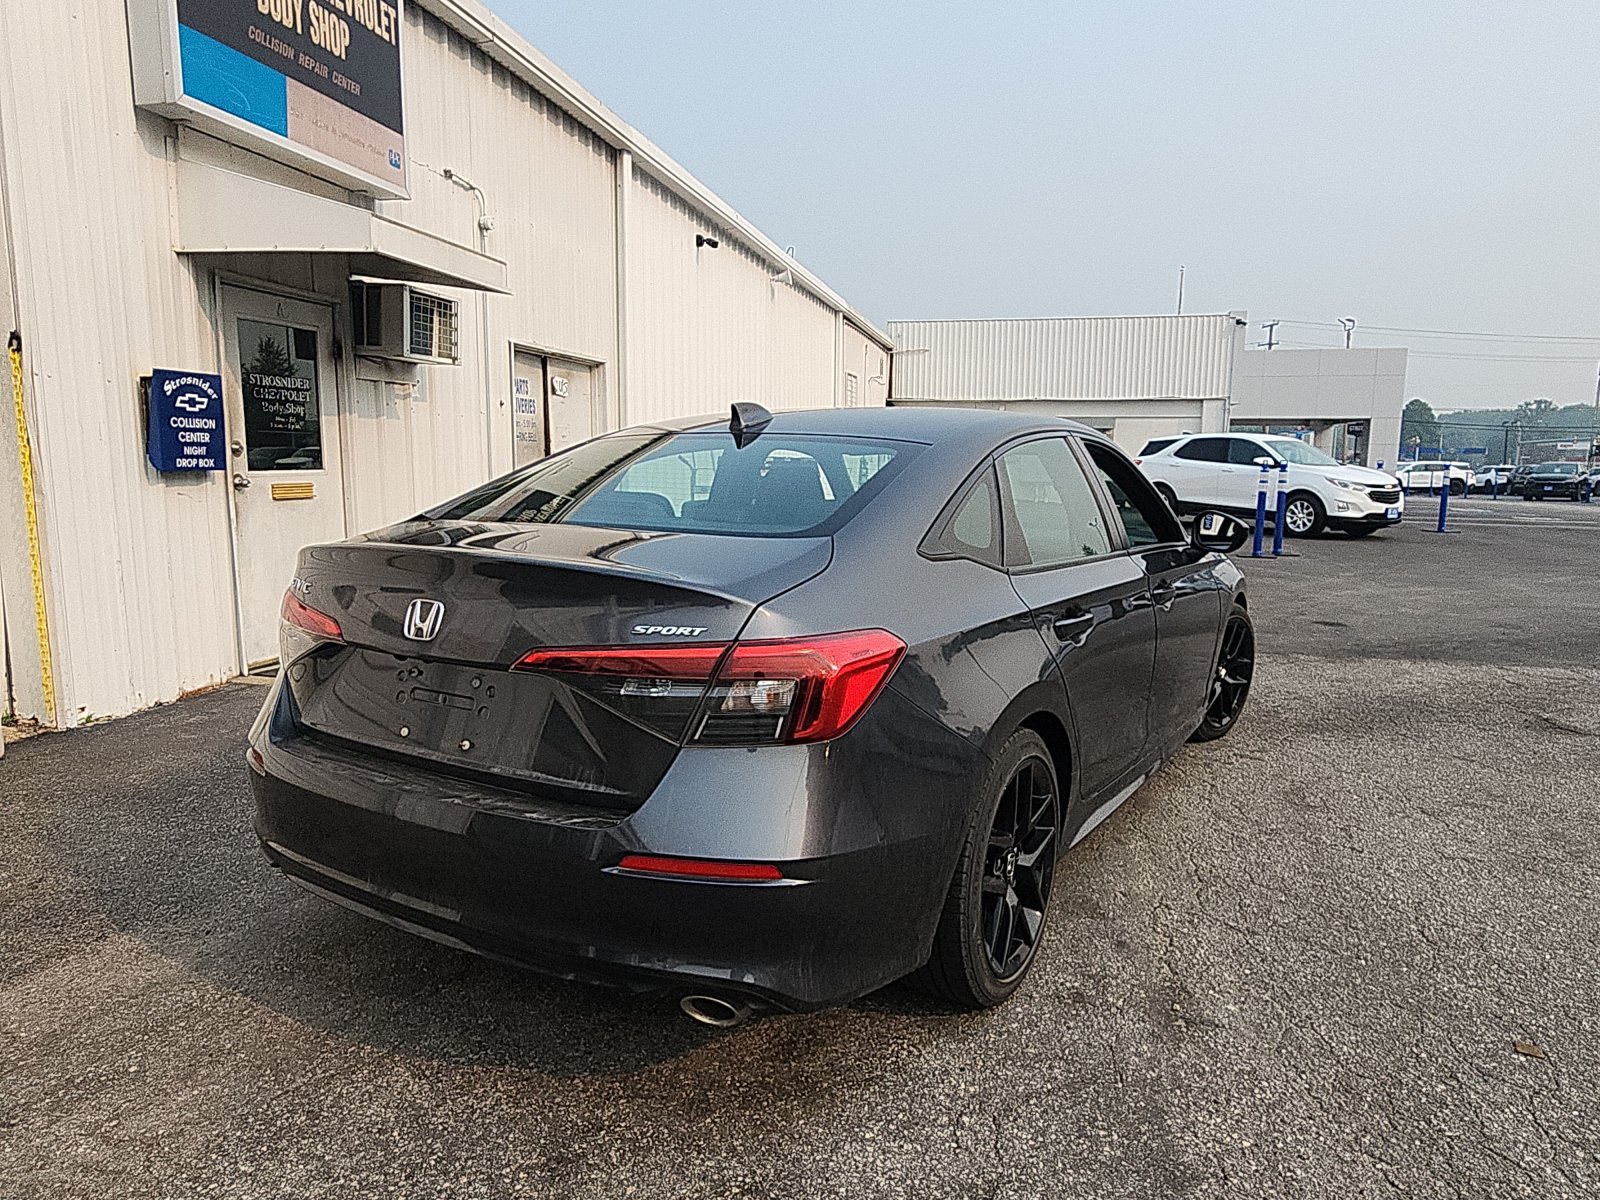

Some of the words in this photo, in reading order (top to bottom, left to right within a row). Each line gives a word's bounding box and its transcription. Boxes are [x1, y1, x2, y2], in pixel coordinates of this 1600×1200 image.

[308, 0, 350, 60] SHOP
[248, 25, 295, 60] COLLISION
[299, 52, 329, 79] REPAIR
[332, 71, 361, 96] CENTER
[163, 376, 218, 399] Strosnider
[249, 373, 310, 390] STROSNIDER
[170, 416, 216, 430] COLLISION
[178, 431, 211, 443] CENTER
[183, 445, 207, 456] NIGHT
[176, 458, 197, 468] DROP
[198, 458, 215, 468] BOX
[631, 625, 709, 637] SPORT
